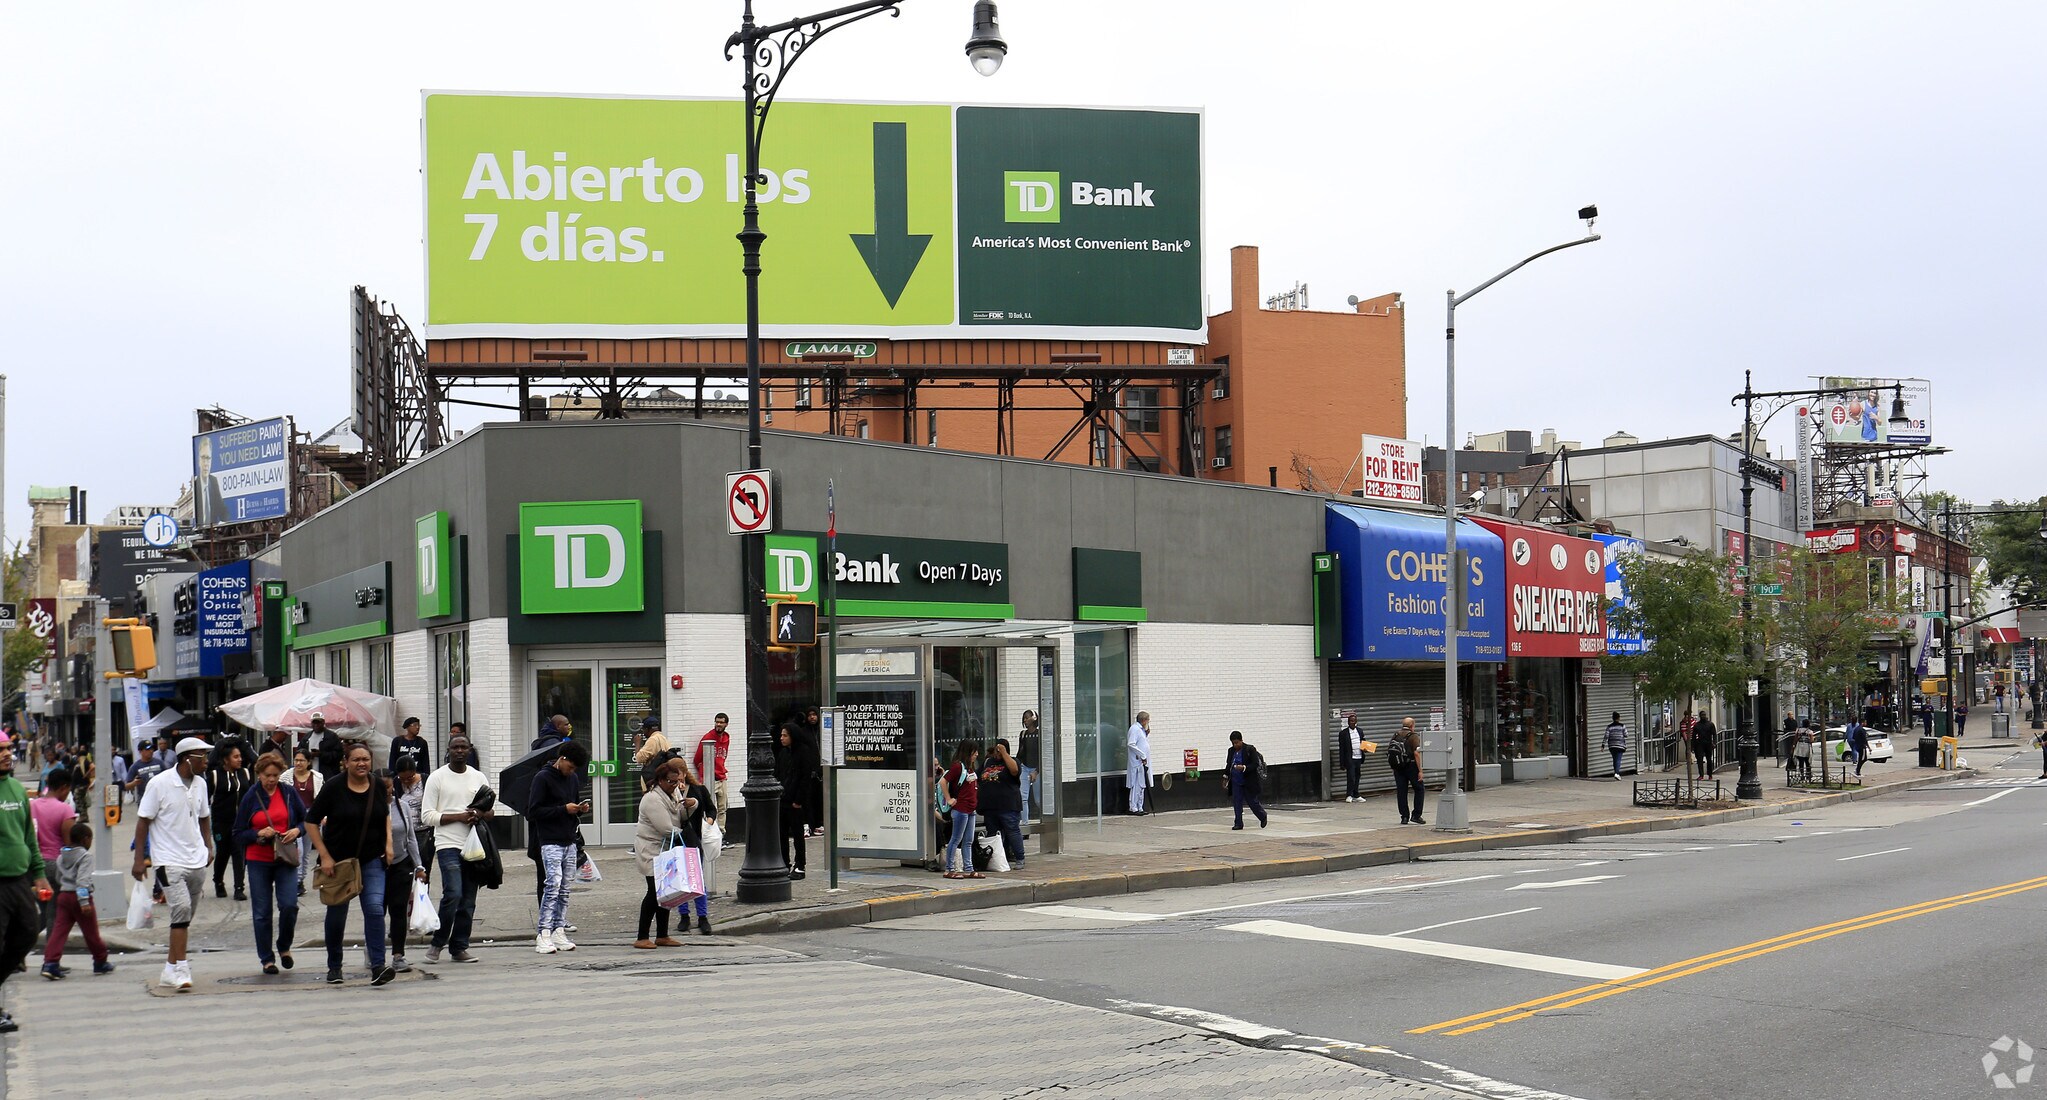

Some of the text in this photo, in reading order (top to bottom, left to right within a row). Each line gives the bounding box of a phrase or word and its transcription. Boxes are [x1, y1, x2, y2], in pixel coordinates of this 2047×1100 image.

[462, 150, 811, 204] Abierto los
[1010, 181, 1155, 212] TD Bank
[464, 211, 664, 262] 7 días.
[972, 236, 1035, 249] America's
[1038, 237, 1071, 249] Most
[1074, 237, 1148, 251] Convenient
[793, 344, 867, 355] LAMAR
[220, 423, 282, 449] SUFFERED PAIN?
[220, 442, 282, 466] YOU NEED LAW!
[1381, 443, 1404, 458] STORE
[1366, 456, 1419, 482] FOR RENT
[1799, 418, 1808, 511] Apple Bank for Savings
[223, 466, 284, 491] 800-PAIN-LAW
[1367, 482, 1420, 500] 212-239-8580
[135, 550, 145, 559] WE
[534, 524, 626, 588] TD
[1316, 558, 1329, 569] TD
[1386, 549, 1484, 586] COHE'S
[769, 548, 1002, 592] TD Bank Open 7 Days
[202, 577, 247, 588] COHEN'S
[203, 590, 240, 599] Fashio
[267, 586, 282, 596] TD
[1761, 585, 1773, 594] 190
[203, 600, 242, 611] Optica
[1388, 592, 1437, 614] Fashion
[1513, 584, 1600, 635] SNEAKER BOX
[0, 620, 15, 628] ANE
[1383, 626, 1392, 636] Eye
[1393, 627, 1407, 635] Exams
[1408, 627, 1411, 635] 7
[1412, 627, 1423, 637] Days
[1428, 628, 1440, 636] Week
[1471, 630, 1490, 638] Accepted
[213, 638, 247, 647] 718-933-0187
[1424, 645, 1428, 653] 1
[1428, 645, 1440, 653] Hour
[860, 704, 874, 712] OFF.
[876, 704, 899, 712] TRYING
[588, 763, 596, 774] D
[601, 763, 615, 774] TD
[881, 782, 910, 790] HUNGER
